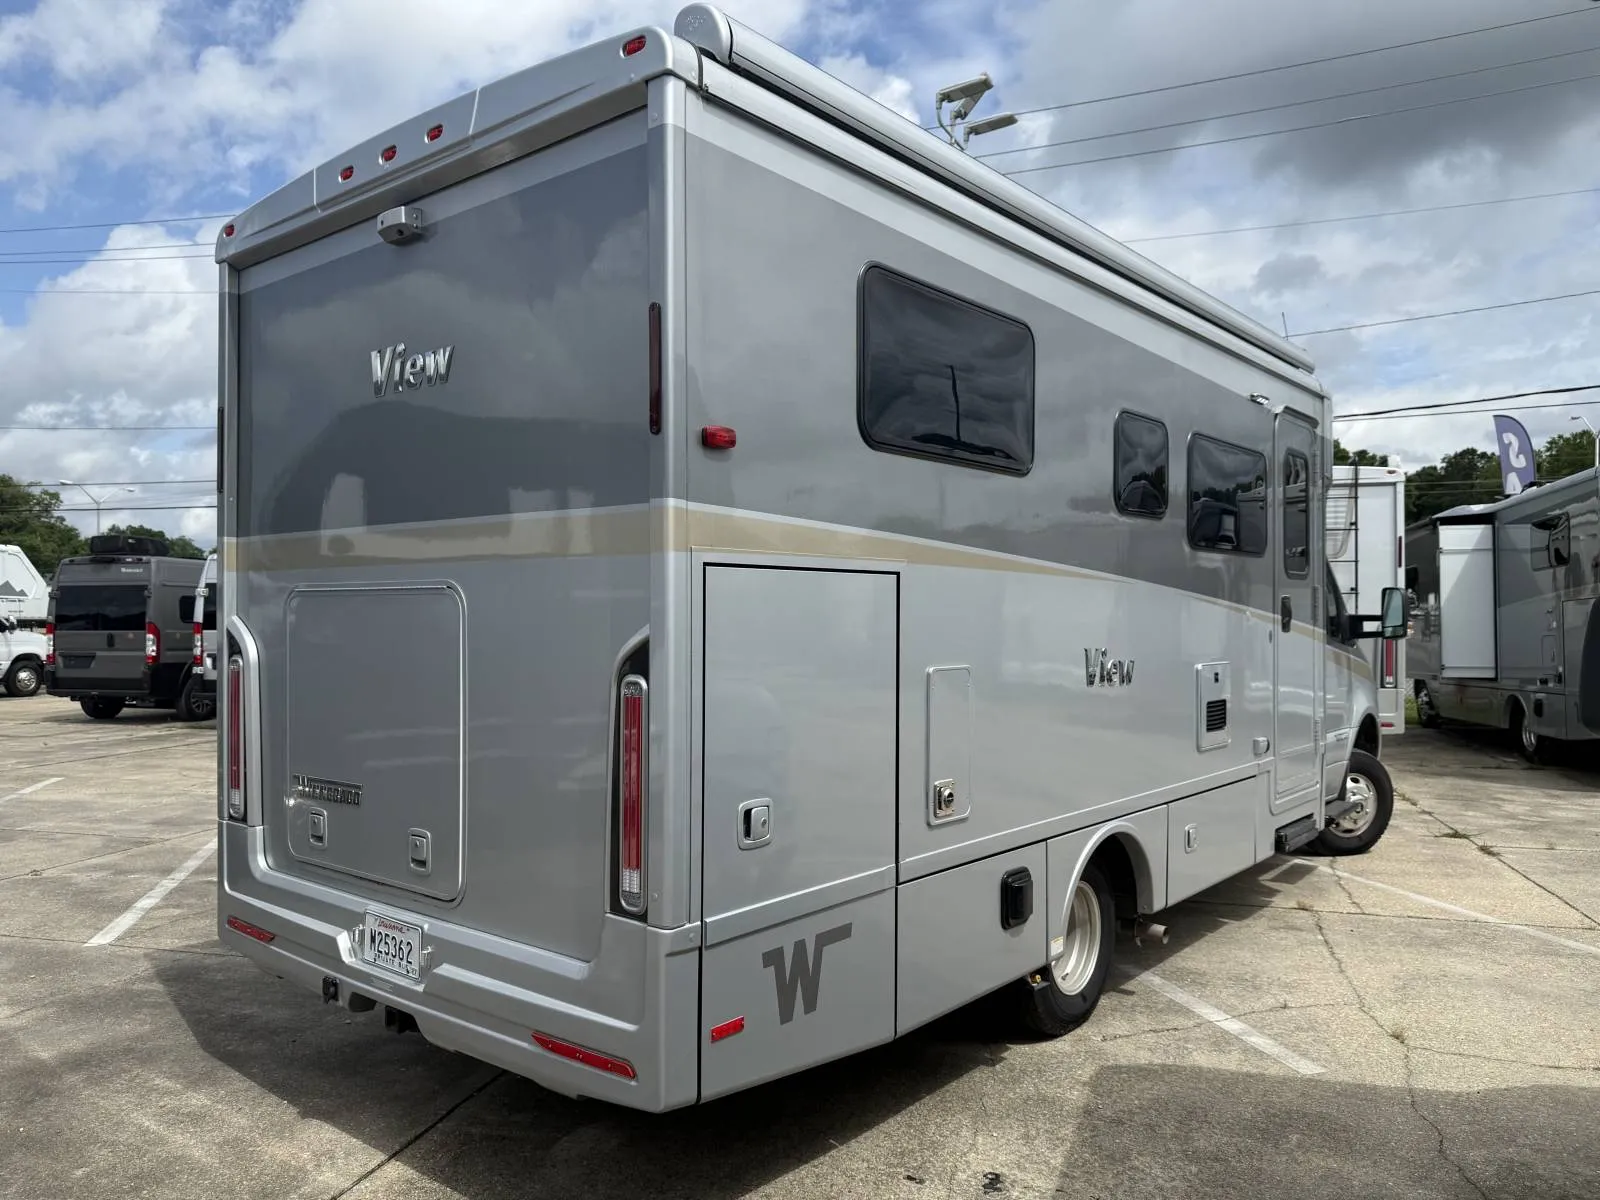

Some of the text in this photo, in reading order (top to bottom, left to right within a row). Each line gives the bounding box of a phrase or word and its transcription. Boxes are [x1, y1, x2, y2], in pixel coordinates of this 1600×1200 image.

[370, 342, 455, 398] View
[1083, 647, 1135, 687] View
[762, 922, 852, 1026] W
